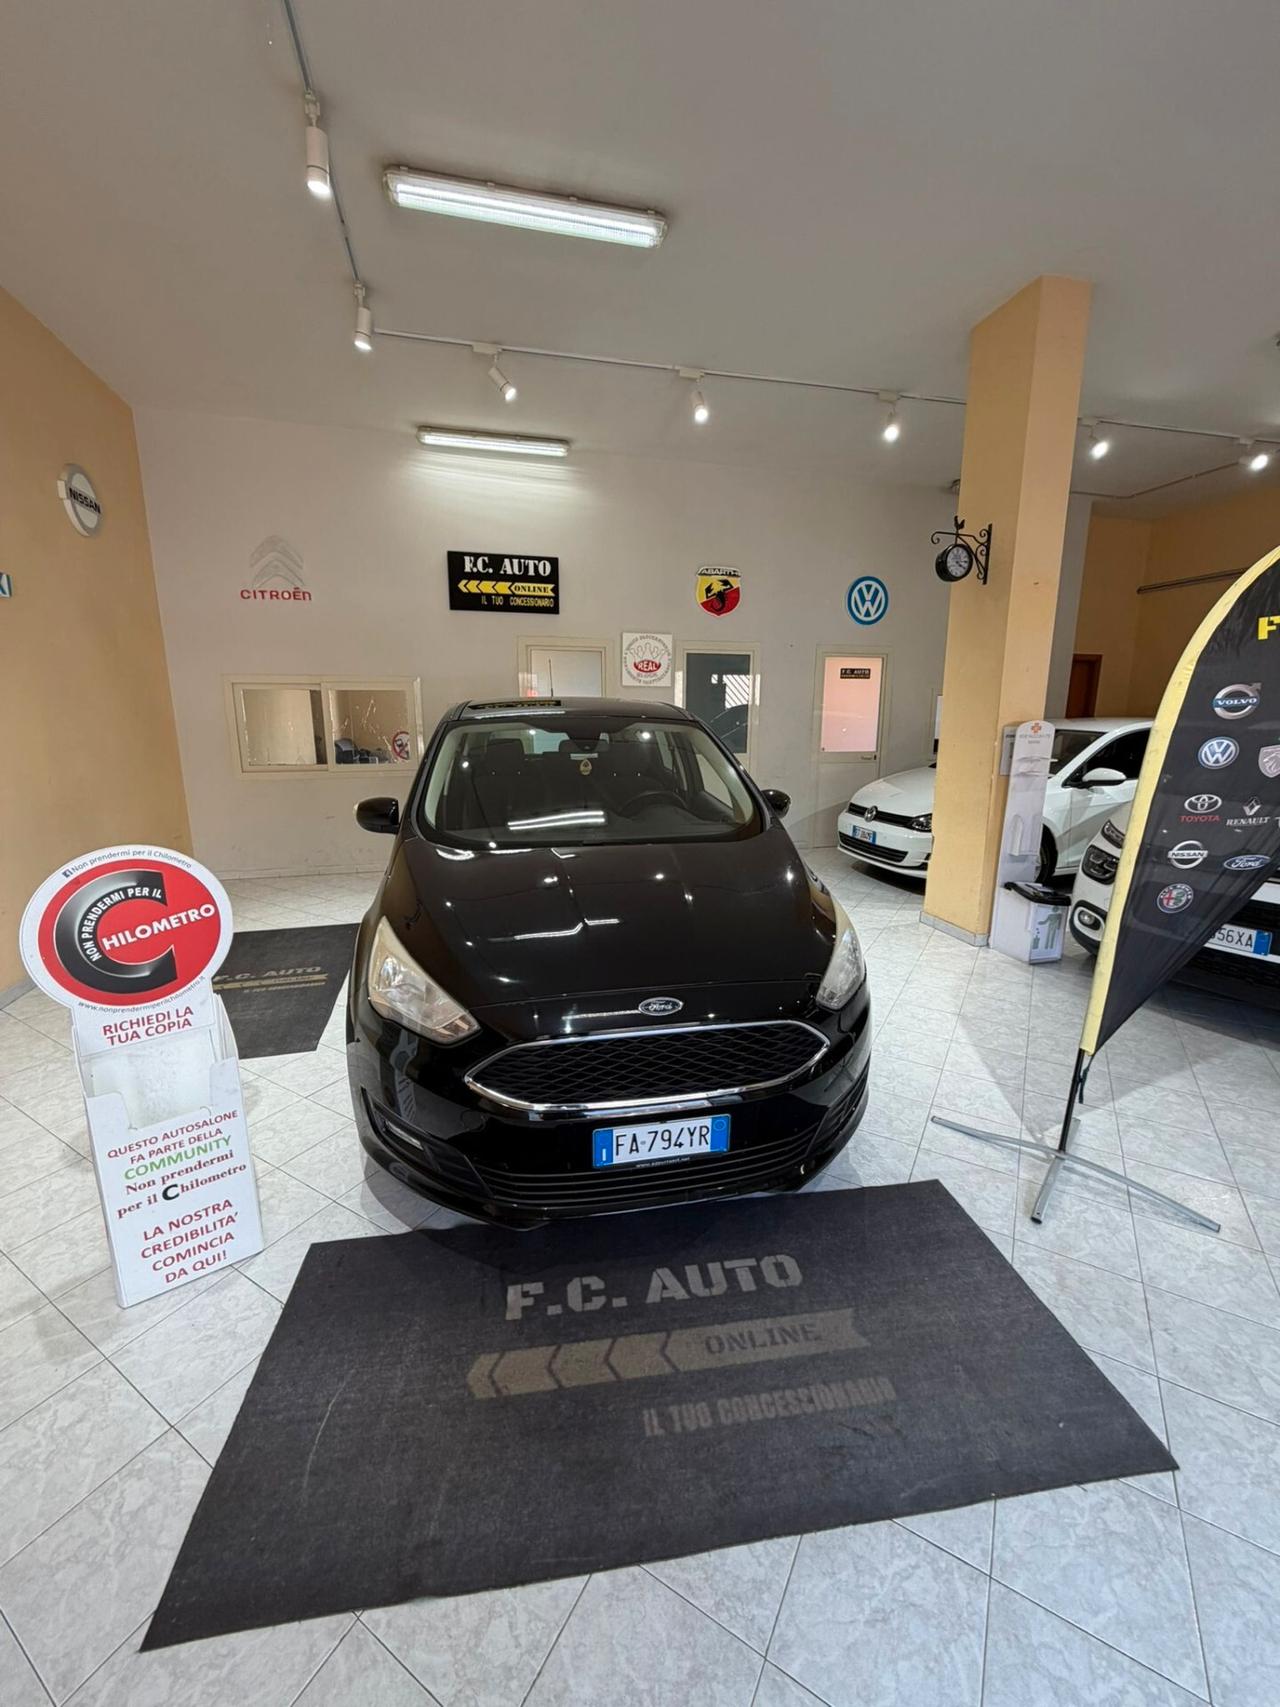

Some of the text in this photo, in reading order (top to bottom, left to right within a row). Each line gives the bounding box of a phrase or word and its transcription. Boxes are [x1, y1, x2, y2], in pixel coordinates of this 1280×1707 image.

[69, 487, 101, 514] NISSAN
[464, 556, 551, 577] F.C. AUTO
[701, 568, 740, 576] ABARTH
[481, 595, 488, 605] IL
[491, 596, 504, 605] TUO
[514, 585, 549, 594] ONLINE
[638, 660, 656, 671] REAL
[1216, 697, 1257, 706] VOLVO
[1179, 815, 1220, 823] TOYOTA
[1226, 816, 1270, 826] RENAULT
[89, 849, 130, 866] prendermi
[153, 850, 192, 869] Chilometro
[1230, 857, 1261, 869] Ford
[82, 887, 162, 962] NON PRENDERMI PER IL
[1209, 926, 1254, 948] 56XA
[263, 966, 321, 977] AUTO
[648, 1001, 674, 1012] Ford
[102, 1006, 194, 1036] RICHIEDI LA
[107, 1018, 192, 1046] TUA COPIA
[107, 1110, 239, 1159] QUESTO AUTOSALONE
[130, 1128, 223, 1165] FA PARTE DELLA
[124, 1135, 232, 1180] COMMUNITY
[125, 1149, 234, 1195] Non prendermi
[116, 1164, 247, 1220] per il Chilometro
[143, 1199, 233, 1241] LA NOSTRA
[152, 1232, 235, 1272] COMINCIA
[165, 1250, 227, 1284] DA QUI!
[505, 1254, 803, 1321] F.C. AUTO
[705, 1323, 820, 1356] ONLINE
[643, 1408, 665, 1437] IL
[669, 1401, 713, 1433] TUO
